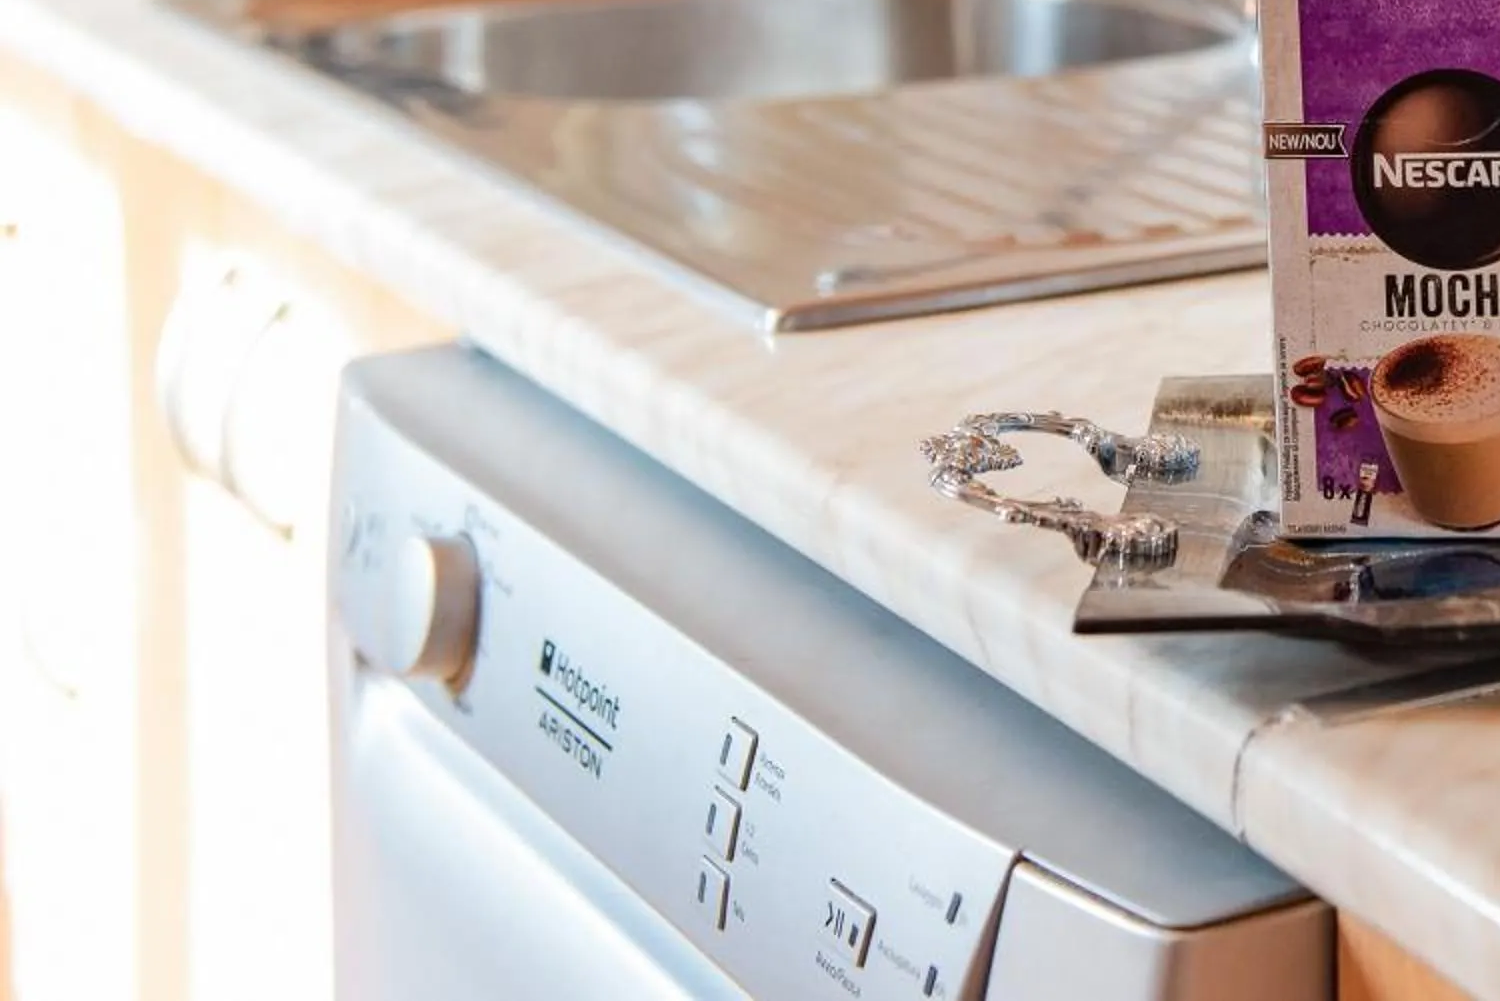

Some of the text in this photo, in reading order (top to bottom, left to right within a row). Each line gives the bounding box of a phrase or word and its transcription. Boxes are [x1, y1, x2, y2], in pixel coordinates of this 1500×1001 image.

[1268, 133, 1337, 150] NEW/NOU
[554, 651, 620, 731] Hotpoint
[538, 711, 603, 780] ARISTON
